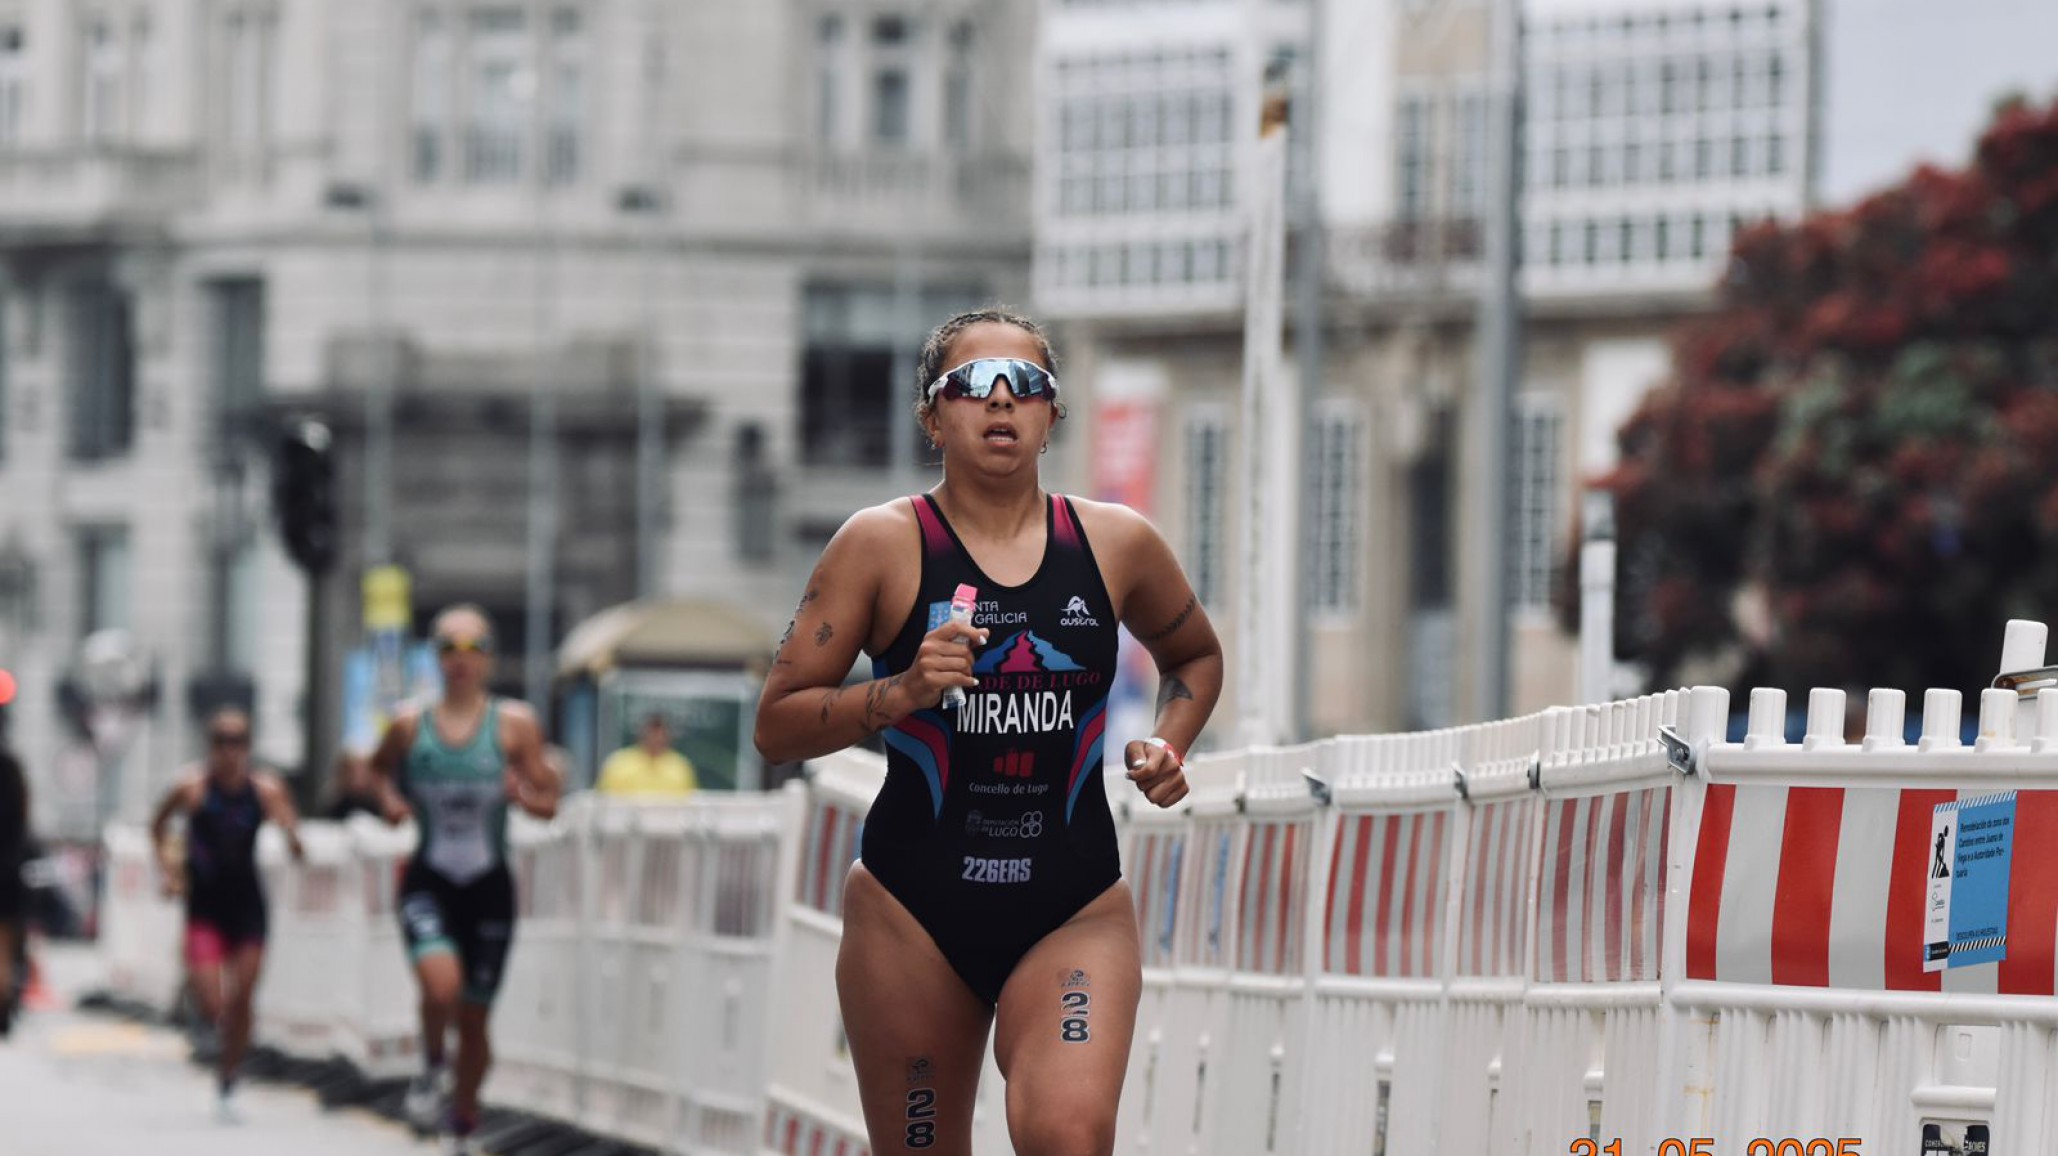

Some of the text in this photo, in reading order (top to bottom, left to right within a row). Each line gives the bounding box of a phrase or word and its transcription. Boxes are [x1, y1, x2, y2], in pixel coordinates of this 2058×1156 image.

[975, 611, 1028, 625] GALICIA
[1016, 674, 1043, 690] DE
[1049, 671, 1101, 687] LUGO
[956, 690, 1075, 734] MIRANDA
[969, 782, 1049, 796] Concello de Lugo
[988, 826, 1018, 837] LUGO
[961, 855, 1032, 884] 226ERS
[1061, 991, 1090, 1044] 28
[905, 1088, 936, 1148] 28
